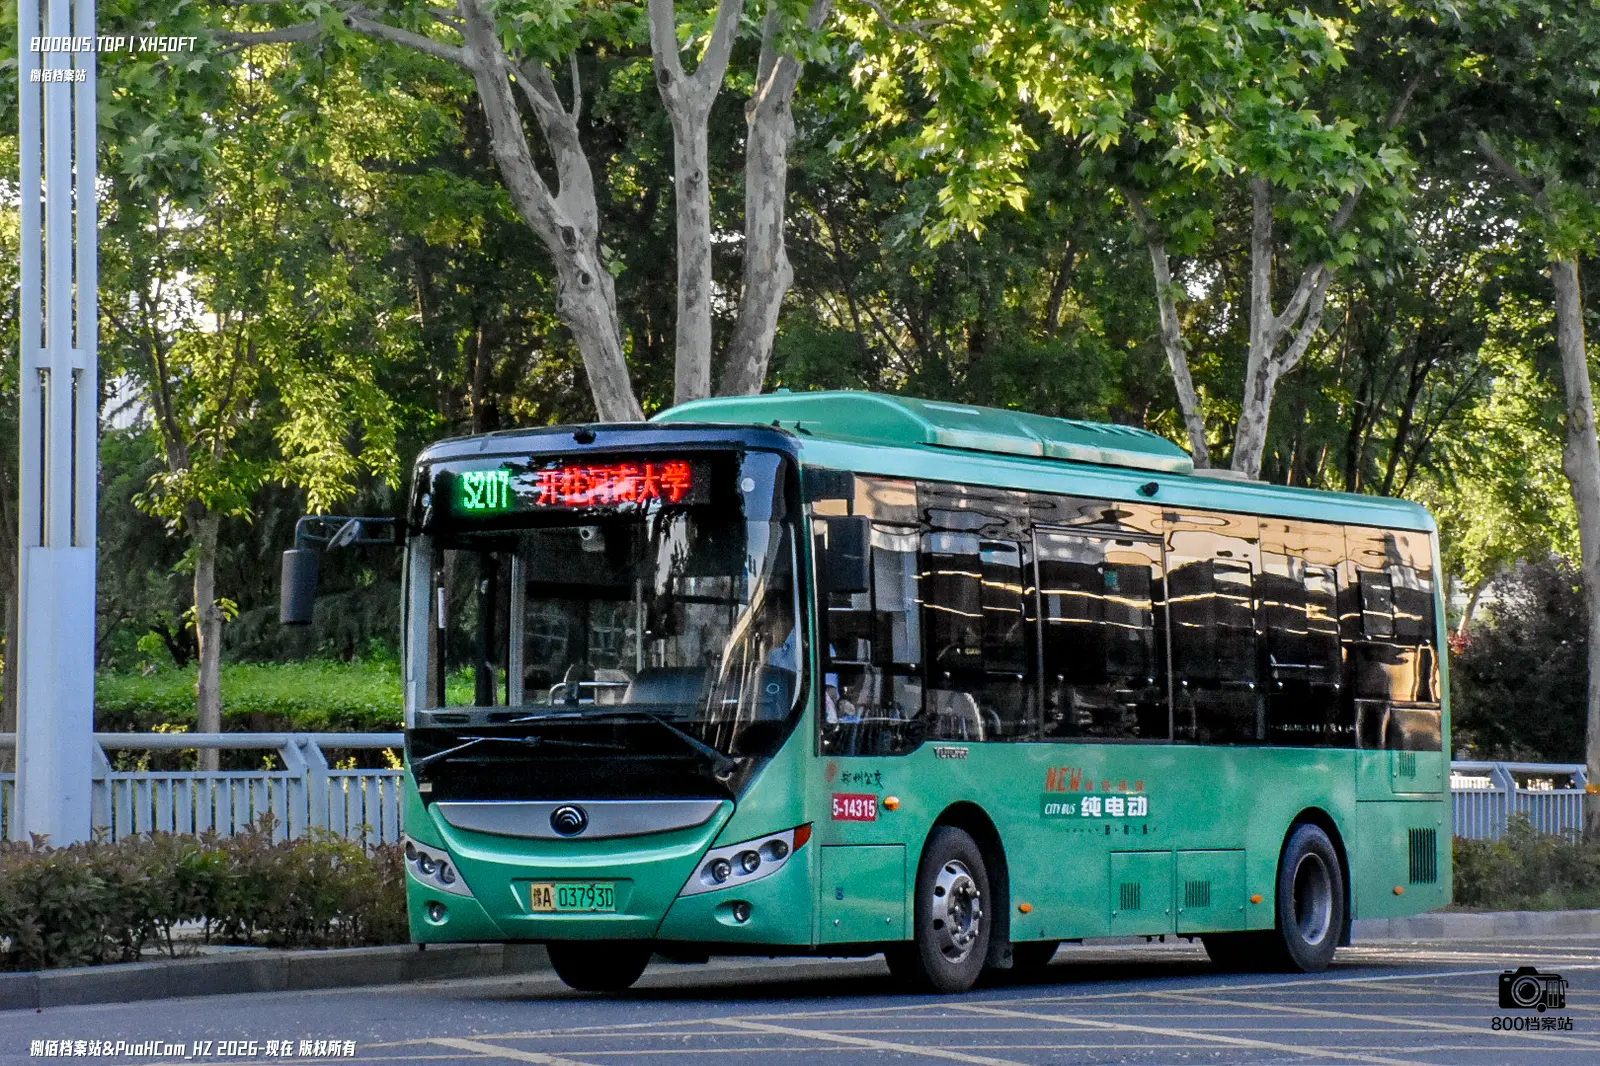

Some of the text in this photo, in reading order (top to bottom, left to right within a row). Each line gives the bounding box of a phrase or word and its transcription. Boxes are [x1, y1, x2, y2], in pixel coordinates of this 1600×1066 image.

[463, 470, 510, 508] S207
[832, 798, 876, 818] 5-14315
[1044, 796, 1148, 817] CITY BUS 纯电动
